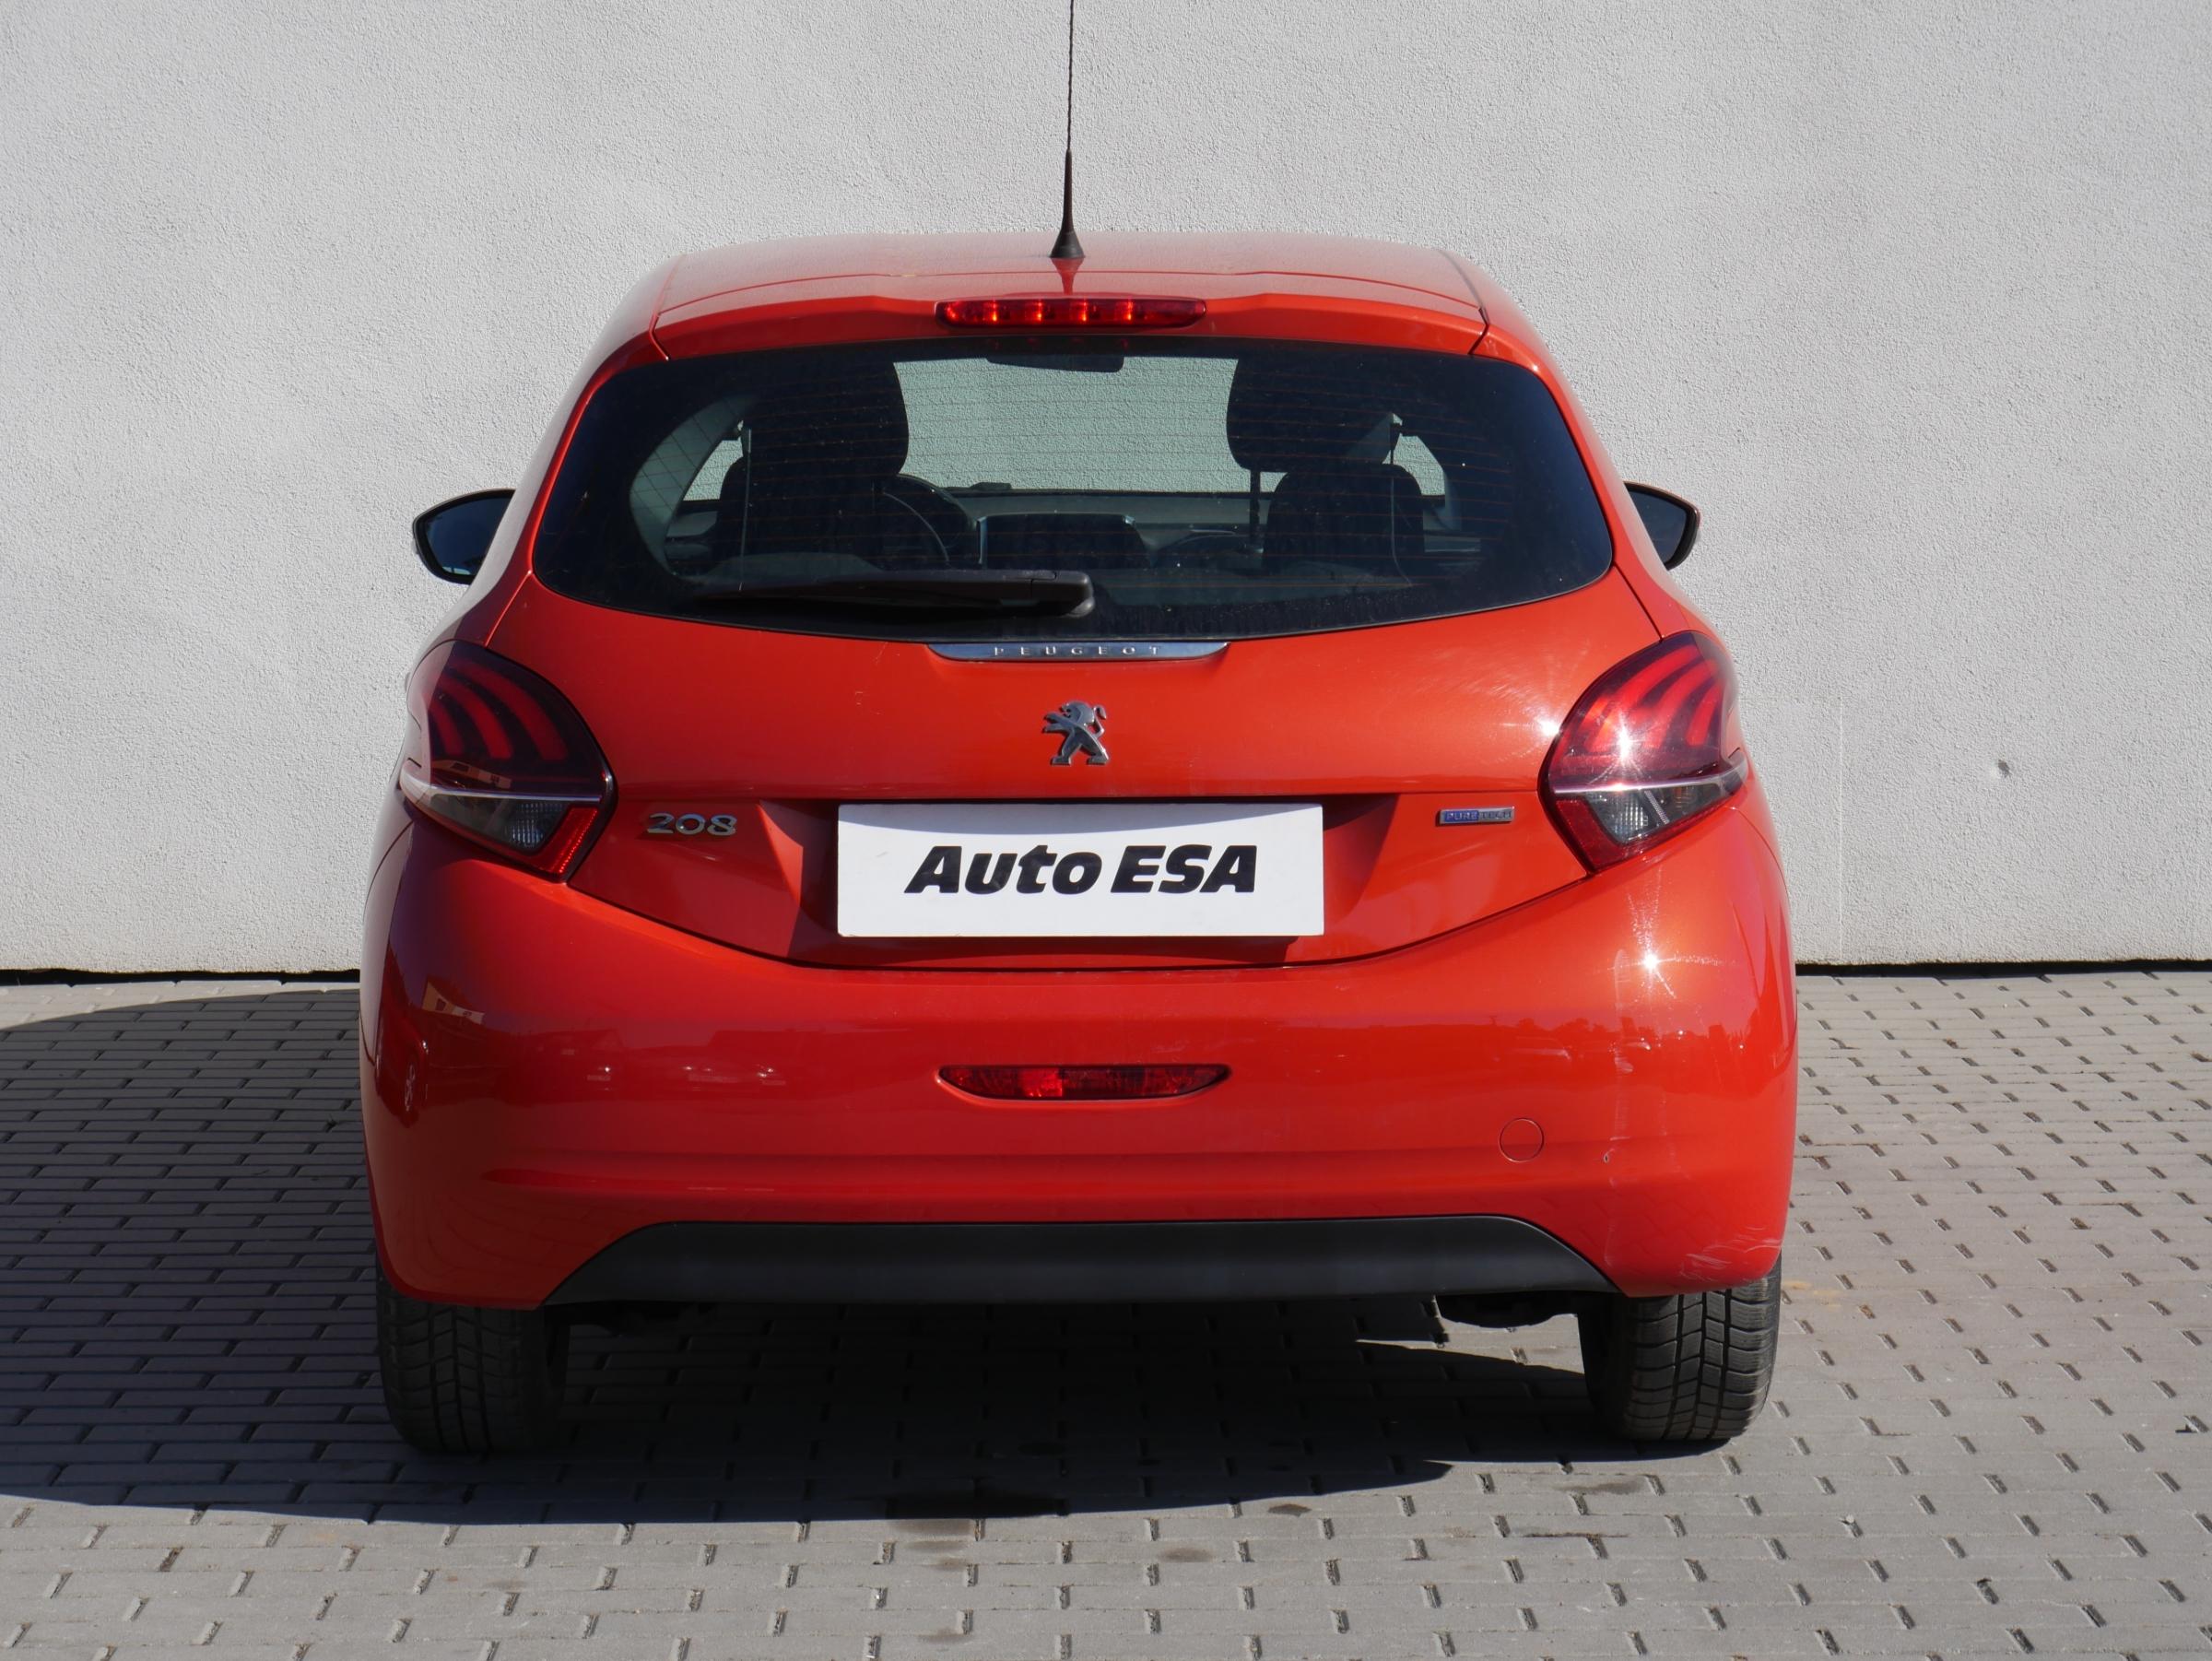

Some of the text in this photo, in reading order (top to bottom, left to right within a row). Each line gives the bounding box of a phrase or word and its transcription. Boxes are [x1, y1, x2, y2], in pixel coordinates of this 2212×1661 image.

[994, 645, 1160, 656] PEUGEOT
[647, 812, 737, 836] 208
[904, 844, 1257, 894] Auto ESA
